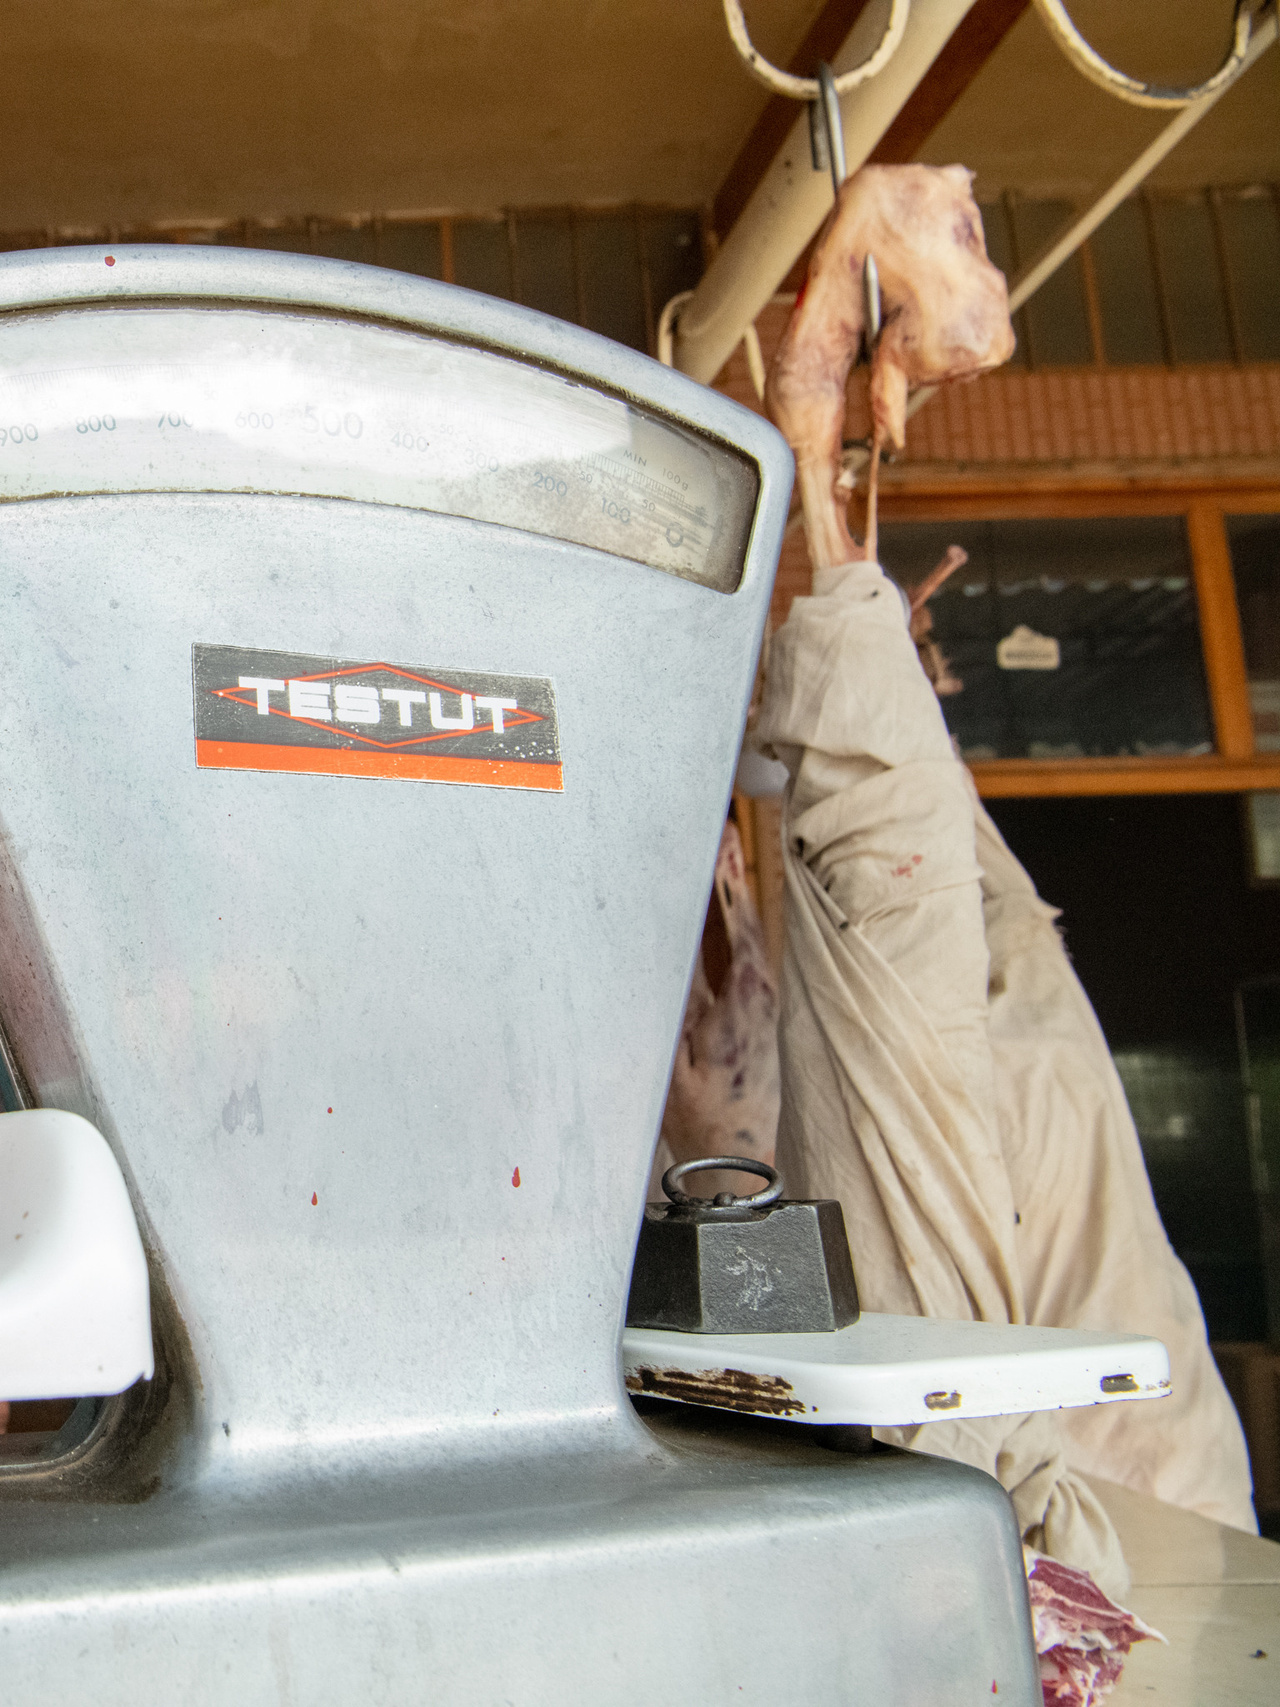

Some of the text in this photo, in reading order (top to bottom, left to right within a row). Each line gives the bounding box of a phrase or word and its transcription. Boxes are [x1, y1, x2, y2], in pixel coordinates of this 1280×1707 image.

[75, 414, 118, 434] 800
[234, 410, 275, 430] 600
[300, 404, 364, 440] 500
[390, 431, 431, 453] 400
[464, 447, 500, 473] 300
[532, 470, 568, 498] 200
[601, 497, 632, 524] 100
[623, 449, 648, 467] MIN
[578, 470, 594, 484] 50
[642, 499, 656, 512] 50
[238, 676, 518, 734] TESTUT
